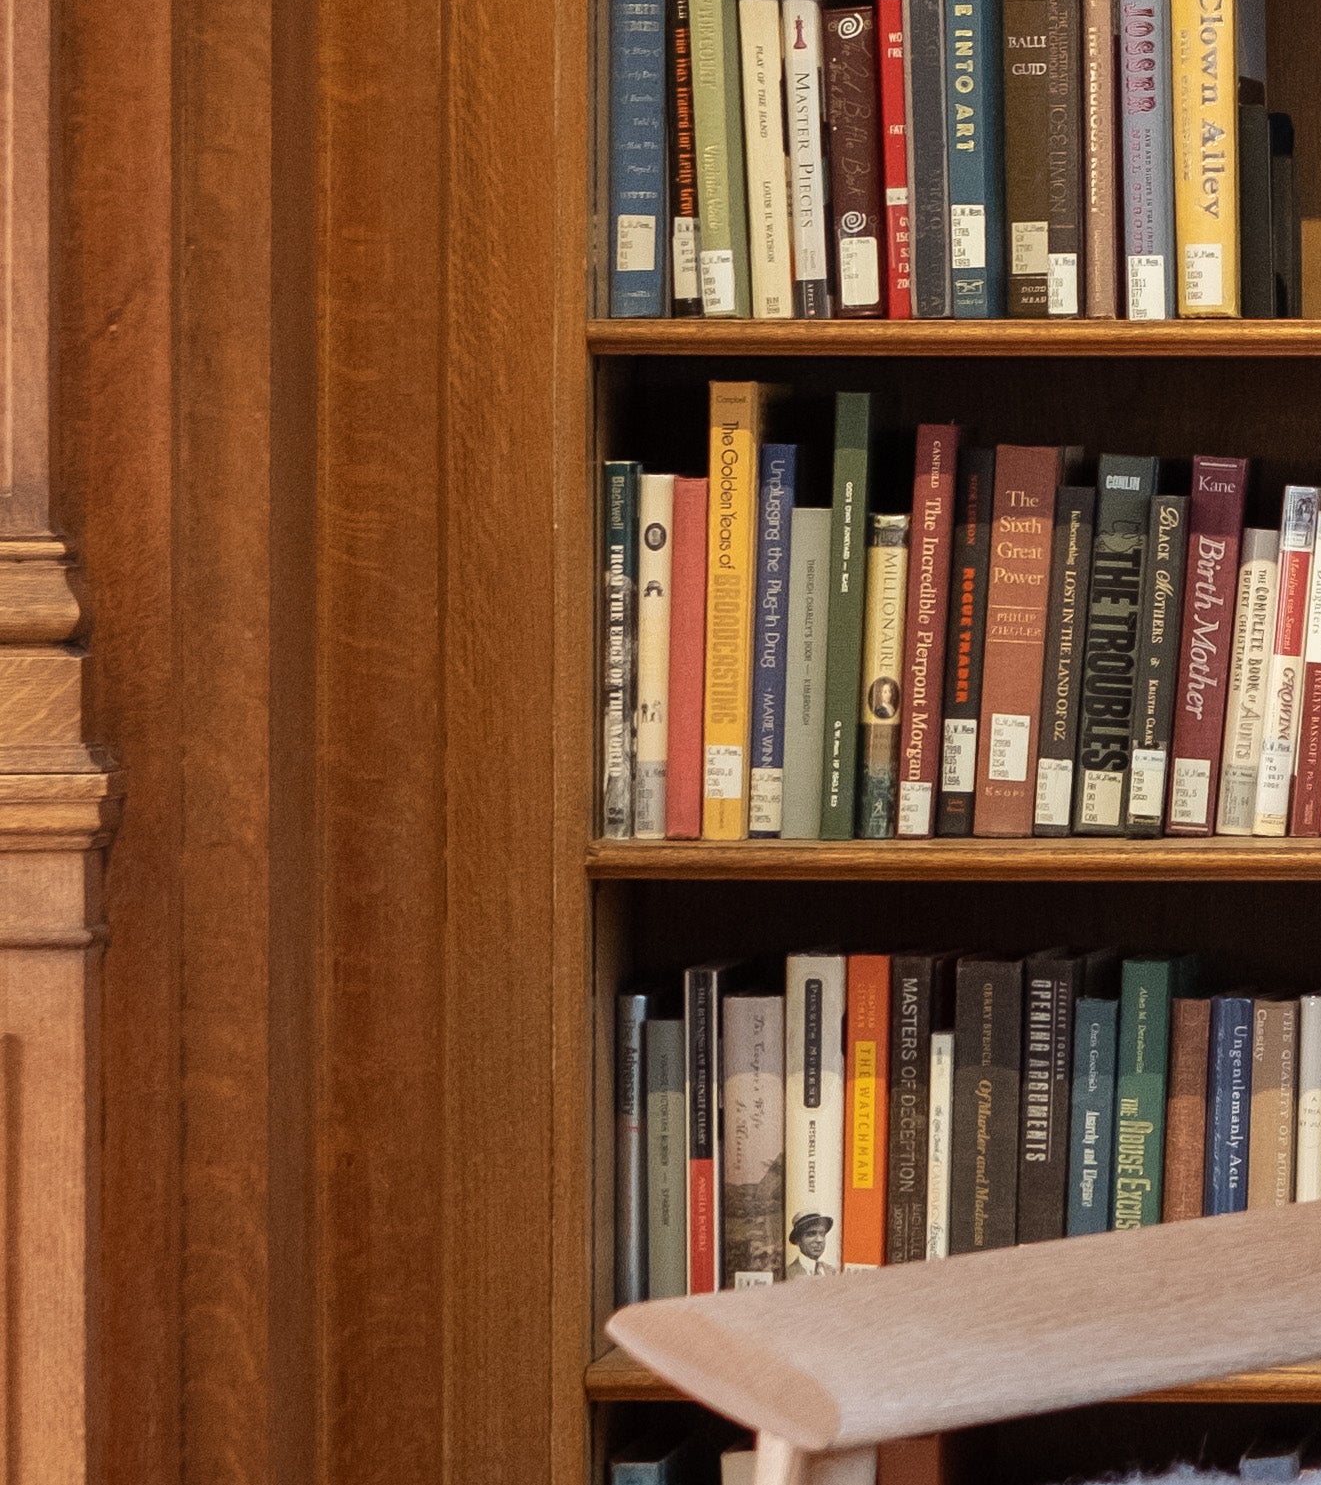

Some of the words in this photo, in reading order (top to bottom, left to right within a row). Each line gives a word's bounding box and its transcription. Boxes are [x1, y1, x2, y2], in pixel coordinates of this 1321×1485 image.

[955, 30, 974, 94] INTO
[956, 104, 974, 152] ART
[924, 497, 940, 530] The
[917, 537, 936, 624] Incredible
[1093, 549, 1142, 605] THE
[1194, 536, 1226, 609] Birth
[910, 630, 933, 706] Pierpont
[1081, 612, 1142, 771] TROUBLES
[1185, 619, 1220, 719] Mother
[907, 712, 929, 780] Morgan
[900, 978, 919, 1060] MASTERS
[900, 1067, 916, 1089] OF
[898, 1094, 916, 1192] DECEPTION
